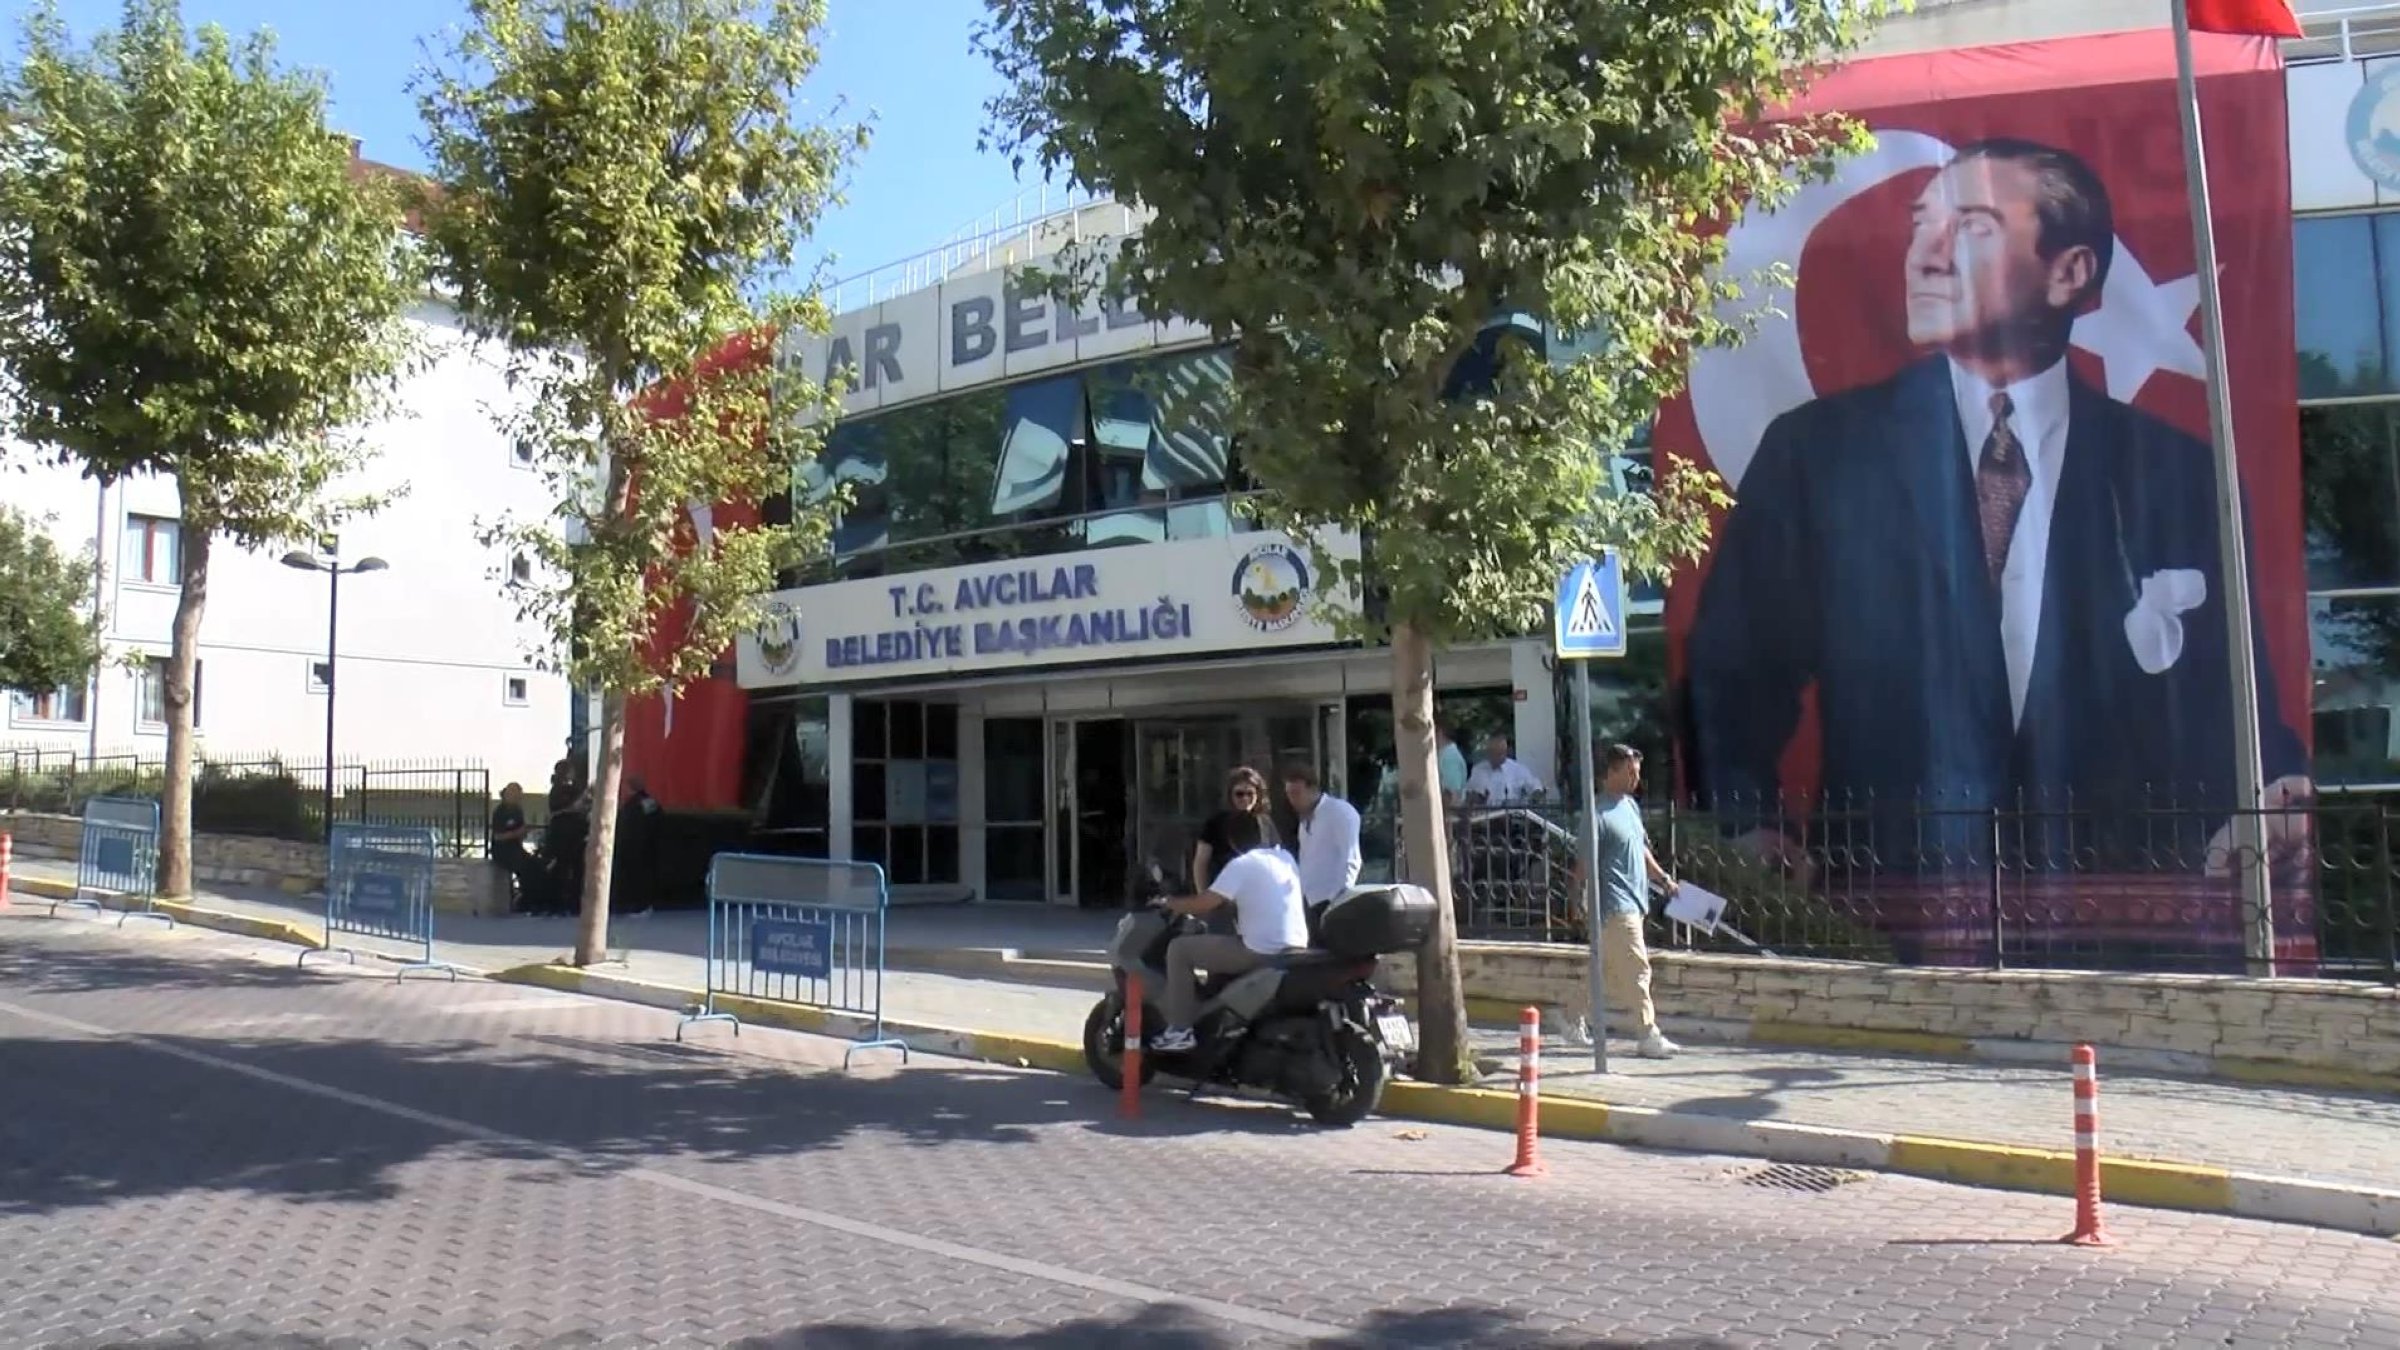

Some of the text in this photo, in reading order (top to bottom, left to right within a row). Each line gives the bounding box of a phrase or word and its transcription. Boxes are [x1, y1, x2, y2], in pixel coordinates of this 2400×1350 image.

[791, 260, 1150, 396] AR BELE
[889, 563, 1098, 618] T.C. AVCILAR
[825, 620, 963, 669] BELEDİYE
[973, 595, 1192, 656] BAŞKANLIĞI
